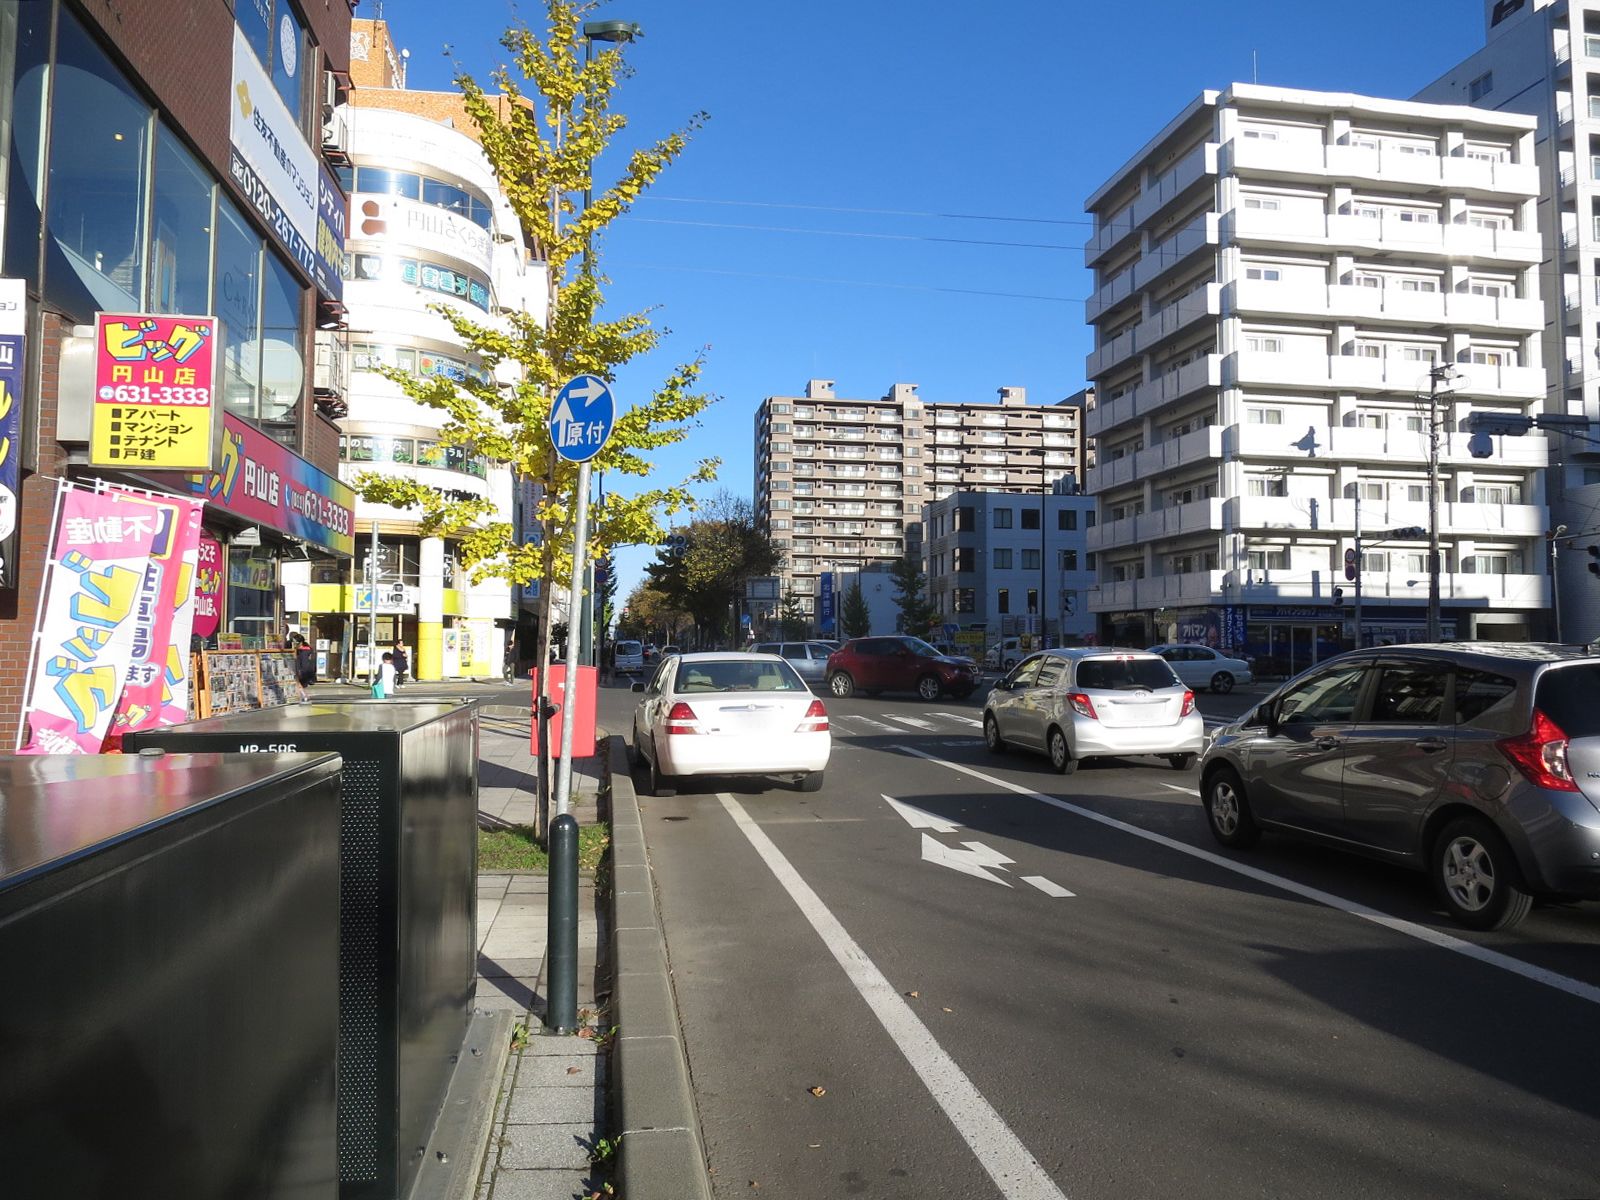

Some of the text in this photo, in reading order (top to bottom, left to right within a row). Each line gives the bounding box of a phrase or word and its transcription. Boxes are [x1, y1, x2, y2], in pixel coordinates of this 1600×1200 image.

[243, 166, 315, 278] 0120-267-772
[104, 319, 210, 364] ビッグ
[112, 365, 196, 385] 円山店
[114, 385, 209, 405] 631-3333
[125, 408, 181, 421] アパート
[124, 421, 193, 435] マンション
[566, 421, 605, 446] 原付
[123, 435, 178, 447] テナント
[123, 448, 156, 461] 戸建
[244, 458, 280, 508] 円山店
[1183, 624, 1207, 638] アパマン
[127, 664, 156, 684] ます
